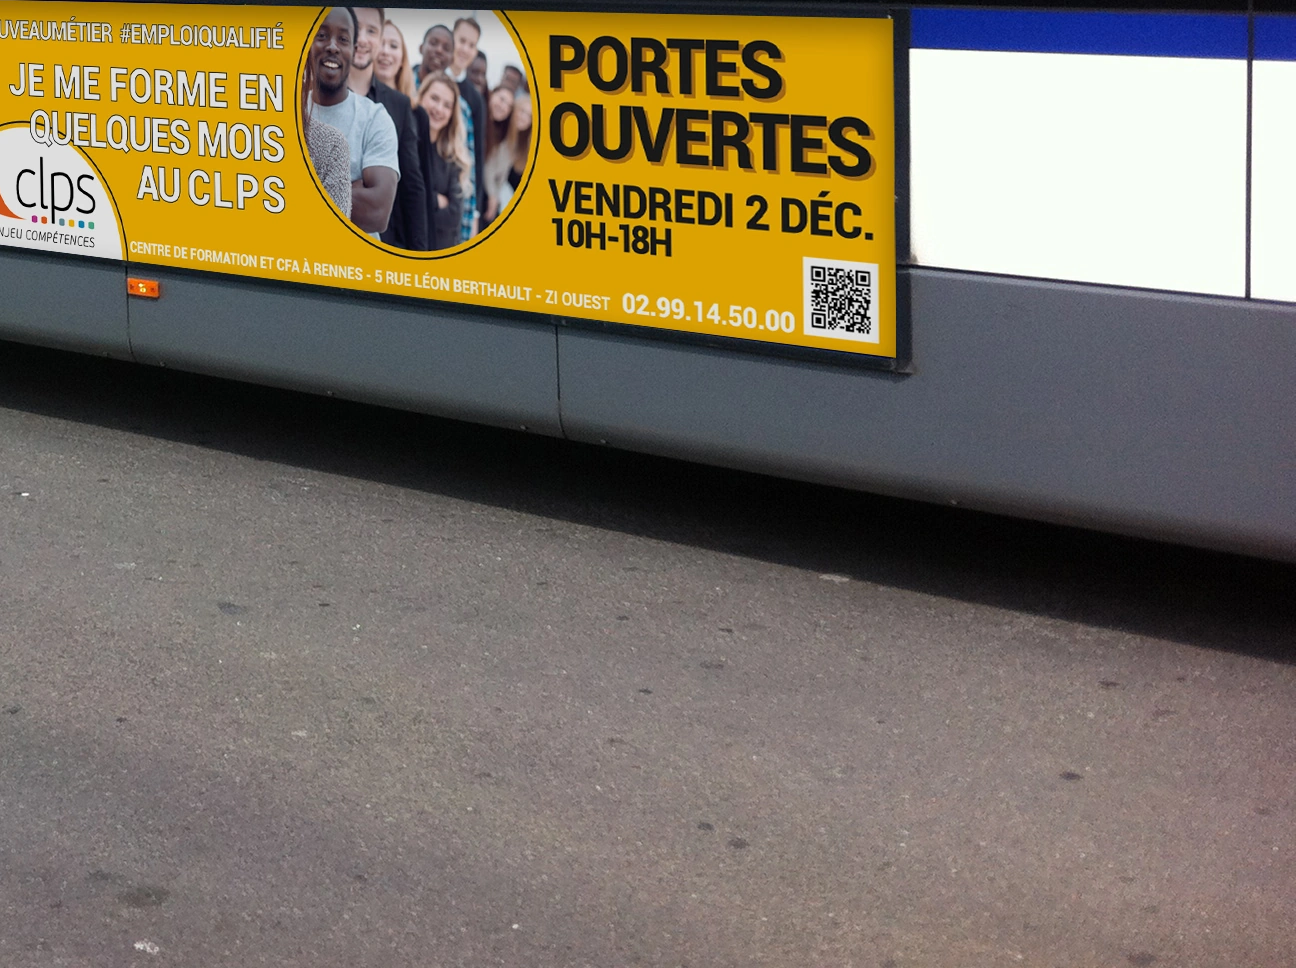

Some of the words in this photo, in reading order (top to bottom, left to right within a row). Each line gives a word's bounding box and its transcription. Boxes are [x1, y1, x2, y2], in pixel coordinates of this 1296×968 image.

[120, 22, 284, 50] #EMPLOIQUALIFIÉ
[9, 62, 45, 97] JE
[54, 64, 101, 101] ME
[110, 66, 228, 109] FORME
[239, 73, 284, 112] EN
[549, 34, 785, 99] PORTES
[29, 109, 191, 155] QUELQUES
[198, 120, 286, 163] MOIS
[549, 101, 875, 179] OUVERTES
[16, 156, 97, 225] clps
[136, 165, 181, 203] AU
[188, 169, 286, 214] CLPS
[548, 178, 734, 229] VENDREDI
[745, 194, 770, 231] 2
[780, 190, 874, 241] DÉC.
[25, 228, 96, 249] COMPÉTENCES
[551, 217, 673, 258] 10H-18H
[129, 240, 172, 258] CENTRE
[173, 245, 189, 260] DE
[189, 247, 258, 268] FORMATION
[259, 255, 275, 270] ET
[276, 257, 301, 274] CFA
[302, 257, 312, 274] À
[313, 262, 364, 281] RENNES
[374, 269, 383, 283] 5
[385, 270, 412, 287] RUE
[414, 271, 451, 292] LÉON
[453, 278, 532, 302] BERTHAULT
[545, 289, 558, 305] ZI
[561, 291, 611, 311] OUEST
[622, 292, 796, 334] 02.99.14.50.00
